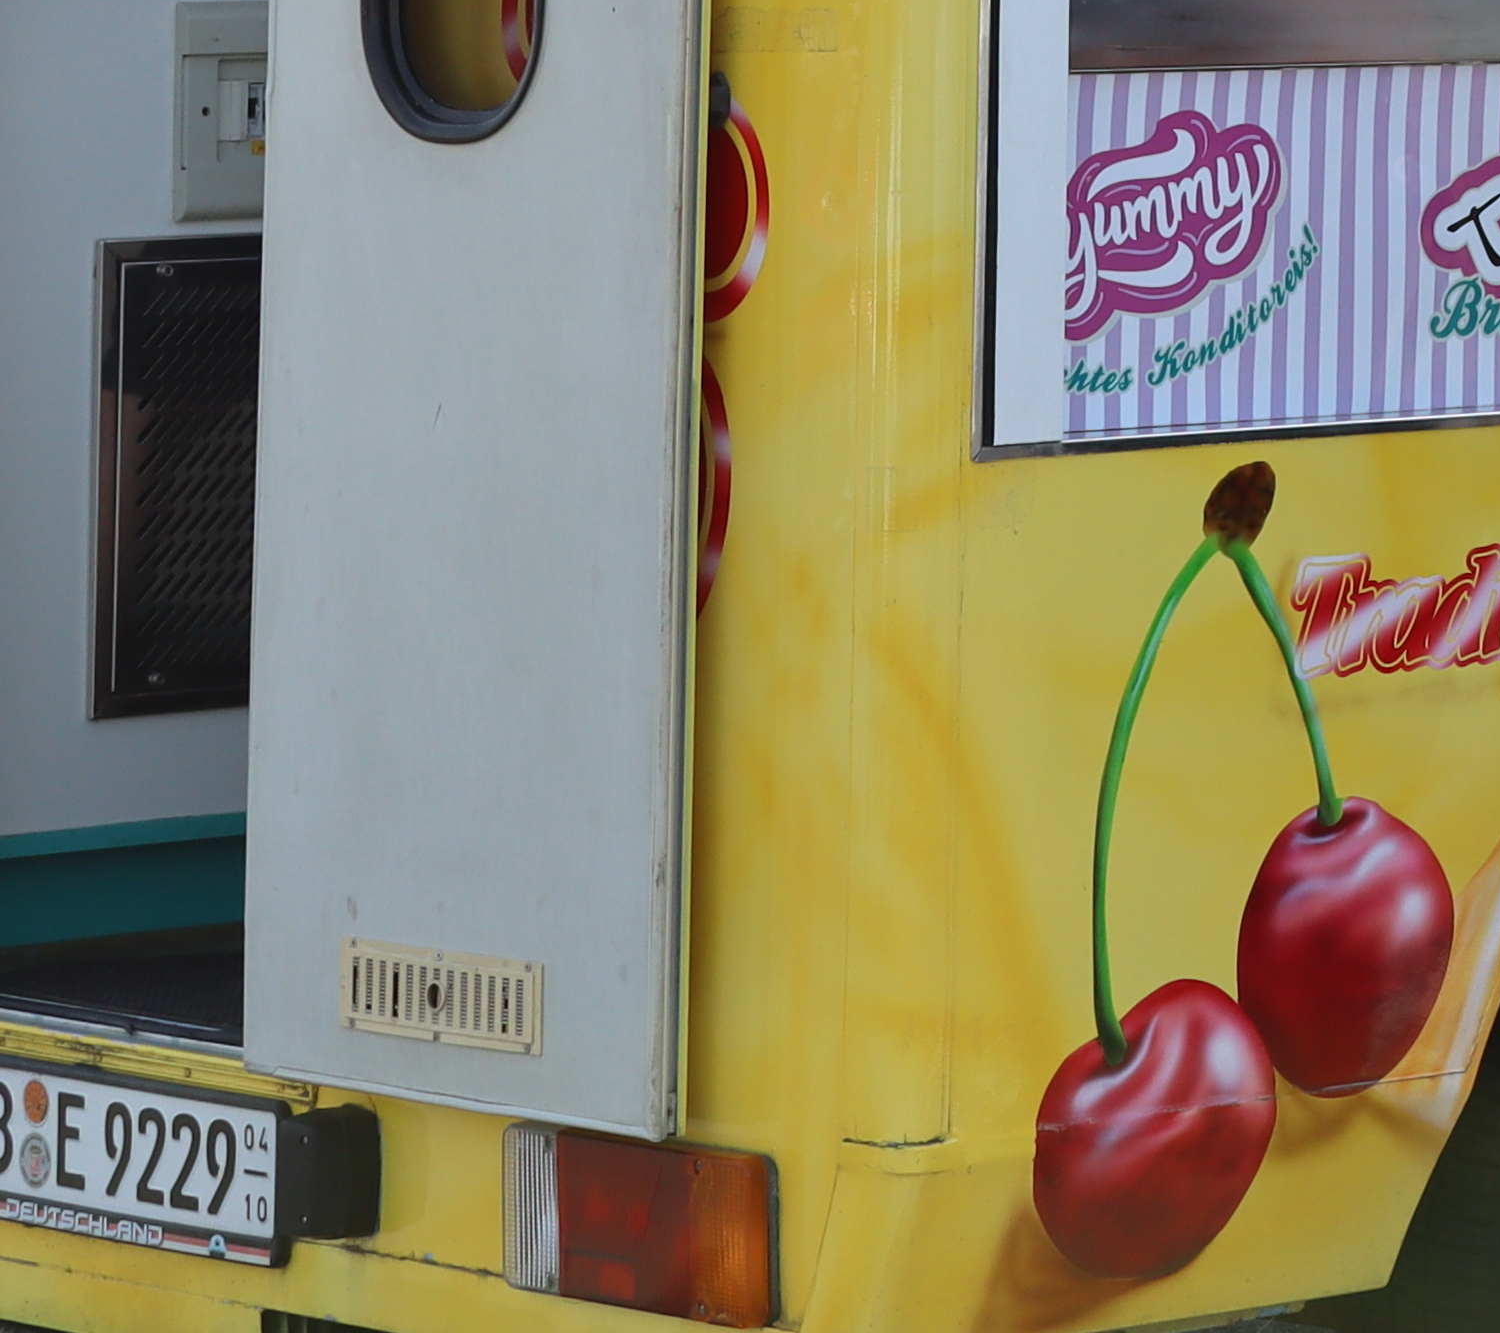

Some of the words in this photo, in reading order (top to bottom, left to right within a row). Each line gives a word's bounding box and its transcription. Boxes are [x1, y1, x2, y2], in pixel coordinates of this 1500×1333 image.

[1148, 223, 1321, 387] Konditoreis!
[56, 1091, 85, 1190] E
[104, 1101, 236, 1216] 9229
[244, 1123, 268, 1151] 04
[4, 1197, 163, 1245] DEUTSCHLAND
[245, 1194, 267, 1222] 10
